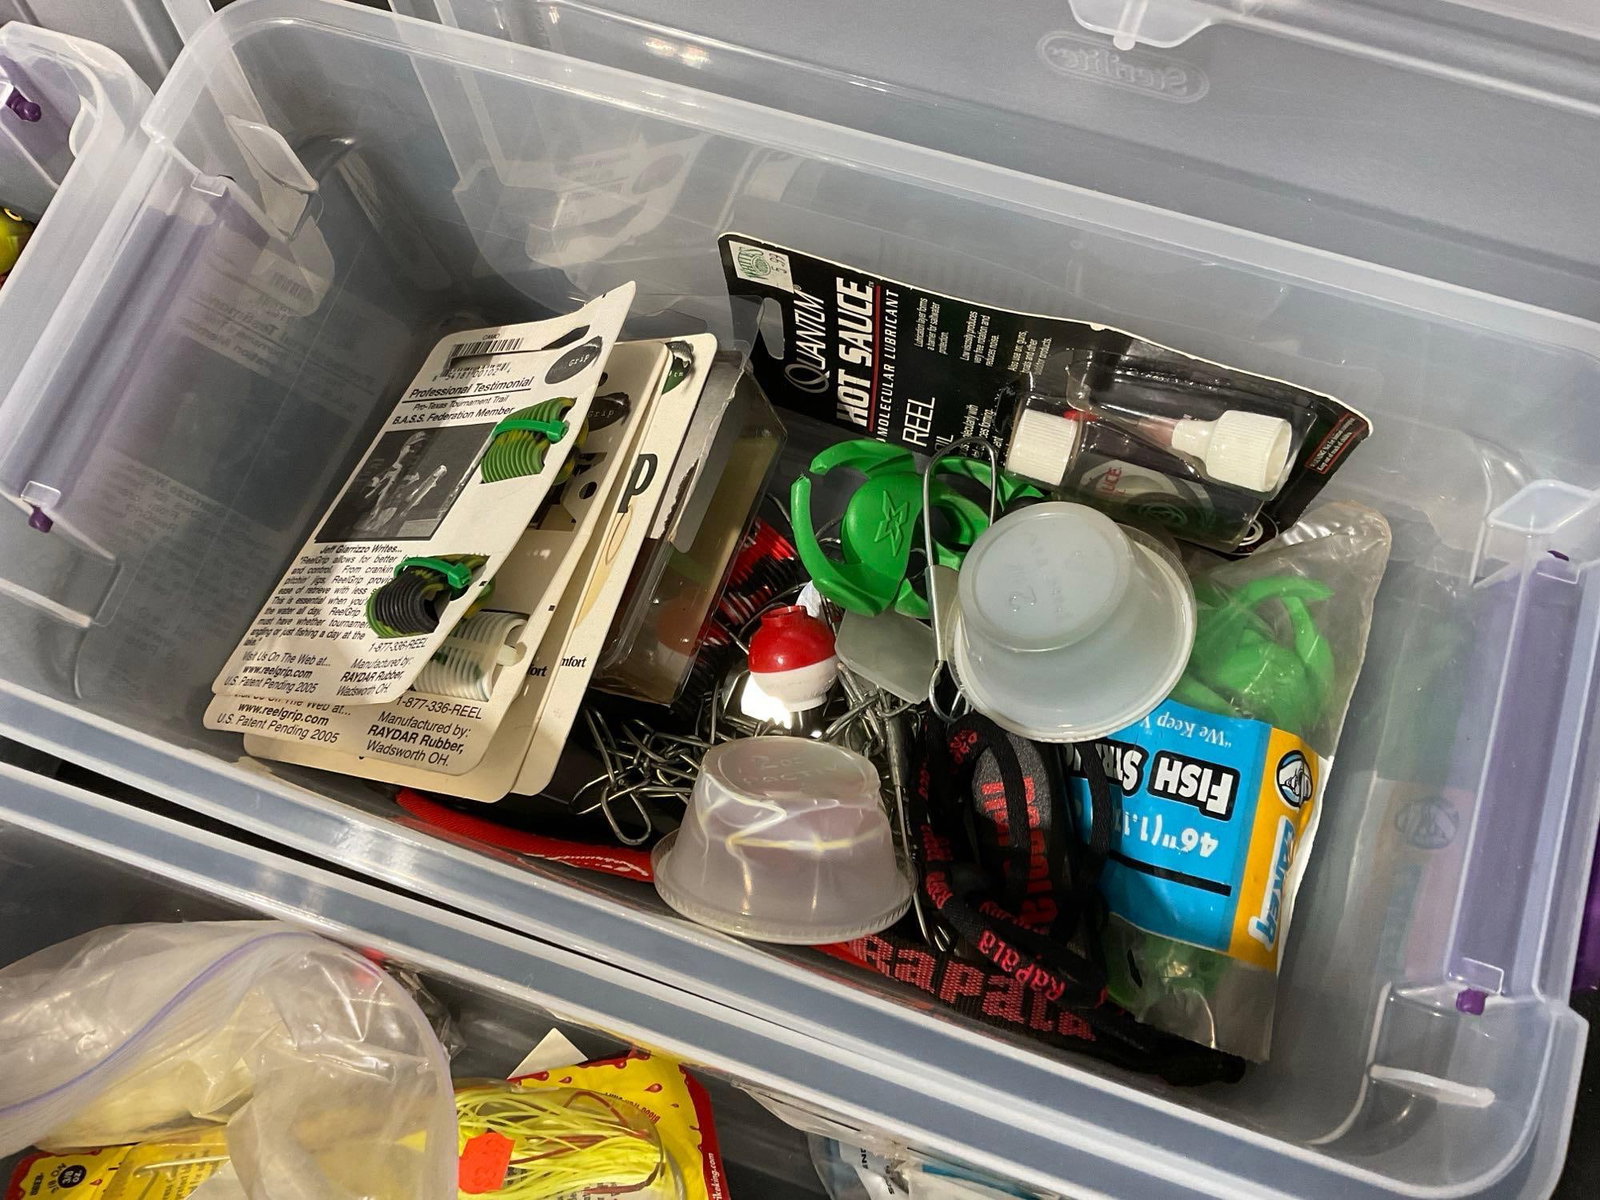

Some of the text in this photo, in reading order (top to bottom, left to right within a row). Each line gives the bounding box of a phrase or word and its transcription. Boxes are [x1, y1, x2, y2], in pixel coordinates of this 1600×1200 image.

[884, 289, 899, 360] LUBRICANT
[785, 289, 830, 394] QUANTUM
[568, 353, 590, 367] Grip
[836, 276, 873, 427] HOT SAUCE
[409, 376, 534, 398] Professional Testimonial
[413, 394, 510, 411] Pro-Texas Tournament Trail
[392, 405, 515, 425] B.A.S.S. Federation Member
[902, 397, 936, 447] REEL
[333, 556, 356, 564] allows
[359, 555, 371, 563] for
[373, 555, 398, 564] better
[291, 567, 304, 575] and
[342, 566, 362, 574] From
[332, 576, 363, 585] ReelGrip
[333, 586, 350, 594] with
[352, 586, 368, 594] less
[329, 607, 360, 617] ReelGrip
[296, 618, 326, 626] whether
[294, 628, 319, 640] fishing
[326, 630, 340, 640] day
[352, 631, 365, 640] the
[268, 652, 280, 661] On
[281, 652, 297, 663] The
[297, 654, 316, 665] Web
[350, 657, 400, 669] Manufactured
[242, 665, 314, 679] www.reelgrip.com
[340, 671, 376, 682] RAYDAR
[240, 676, 263, 688] Patent
[262, 678, 297, 694] Pending
[295, 682, 319, 694] 2005
[336, 685, 377, 697] Wadsworth
[238, 703, 330, 726] www.reelgrip.com
[396, 696, 482, 720] 1-877-336-REEL
[216, 713, 340, 744] U.S. Patent Pending 2005
[377, 711, 471, 740] Manufactured by:
[1156, 711, 1196, 739] Keep
[367, 724, 464, 755] RAYDAR Rubber,
[366, 739, 449, 767] Wadsworth OH.
[1154, 757, 1234, 815] FISH
